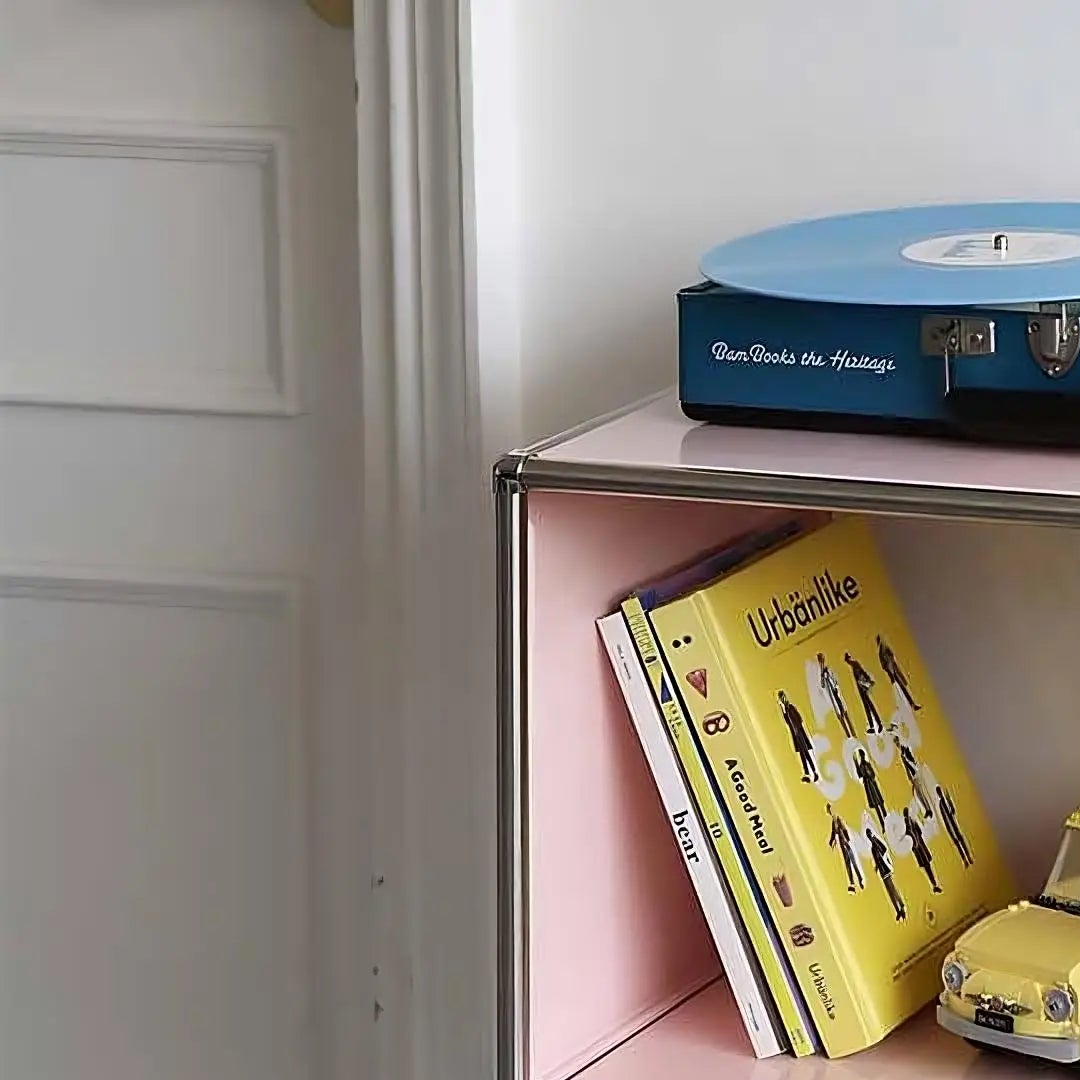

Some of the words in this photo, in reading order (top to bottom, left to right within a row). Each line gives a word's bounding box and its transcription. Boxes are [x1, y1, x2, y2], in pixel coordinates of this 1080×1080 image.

[801, 351, 826, 366] the
[746, 568, 861, 647] Urbänlike
[724, 759, 738, 771] A
[730, 770, 758, 813] Good
[672, 809, 700, 863] bear
